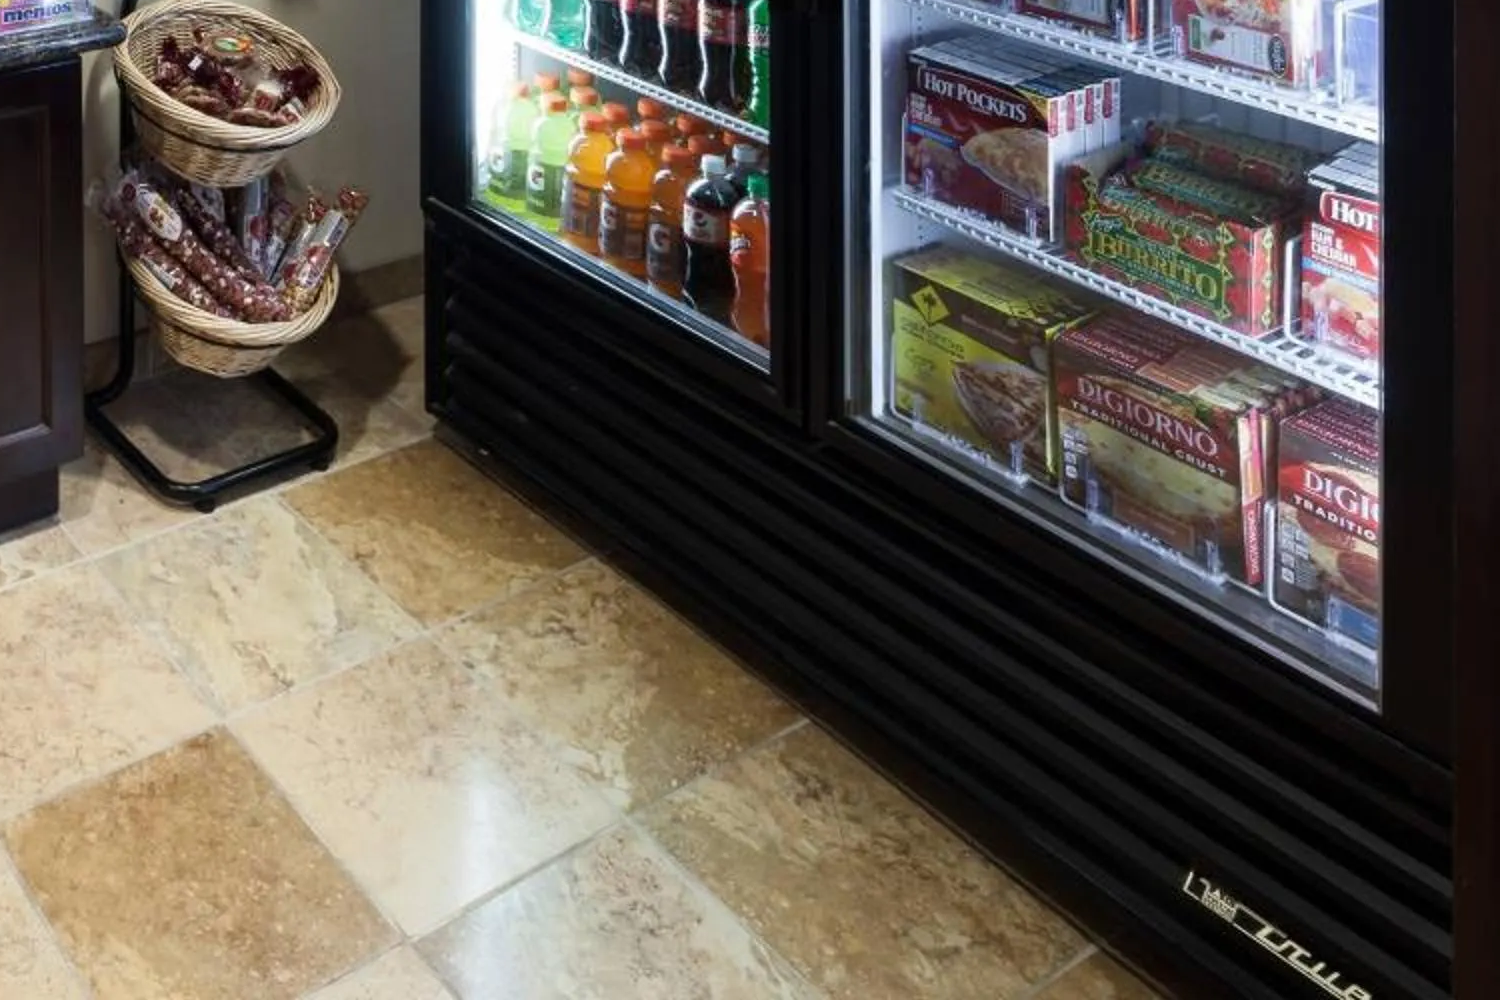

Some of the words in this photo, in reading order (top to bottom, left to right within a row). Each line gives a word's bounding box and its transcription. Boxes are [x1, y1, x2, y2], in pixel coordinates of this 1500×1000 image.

[3, 1, 72, 24] mentos
[924, 70, 957, 99] HOT
[956, 85, 1028, 123] POCKETS
[1070, 399, 1173, 452] TRADITIONAL
[1176, 448, 1228, 479] CRUST
[1076, 376, 1220, 458] DIGIORNO
[1293, 495, 1378, 542] TRADITIO
[1304, 468, 1379, 527] DIGI
